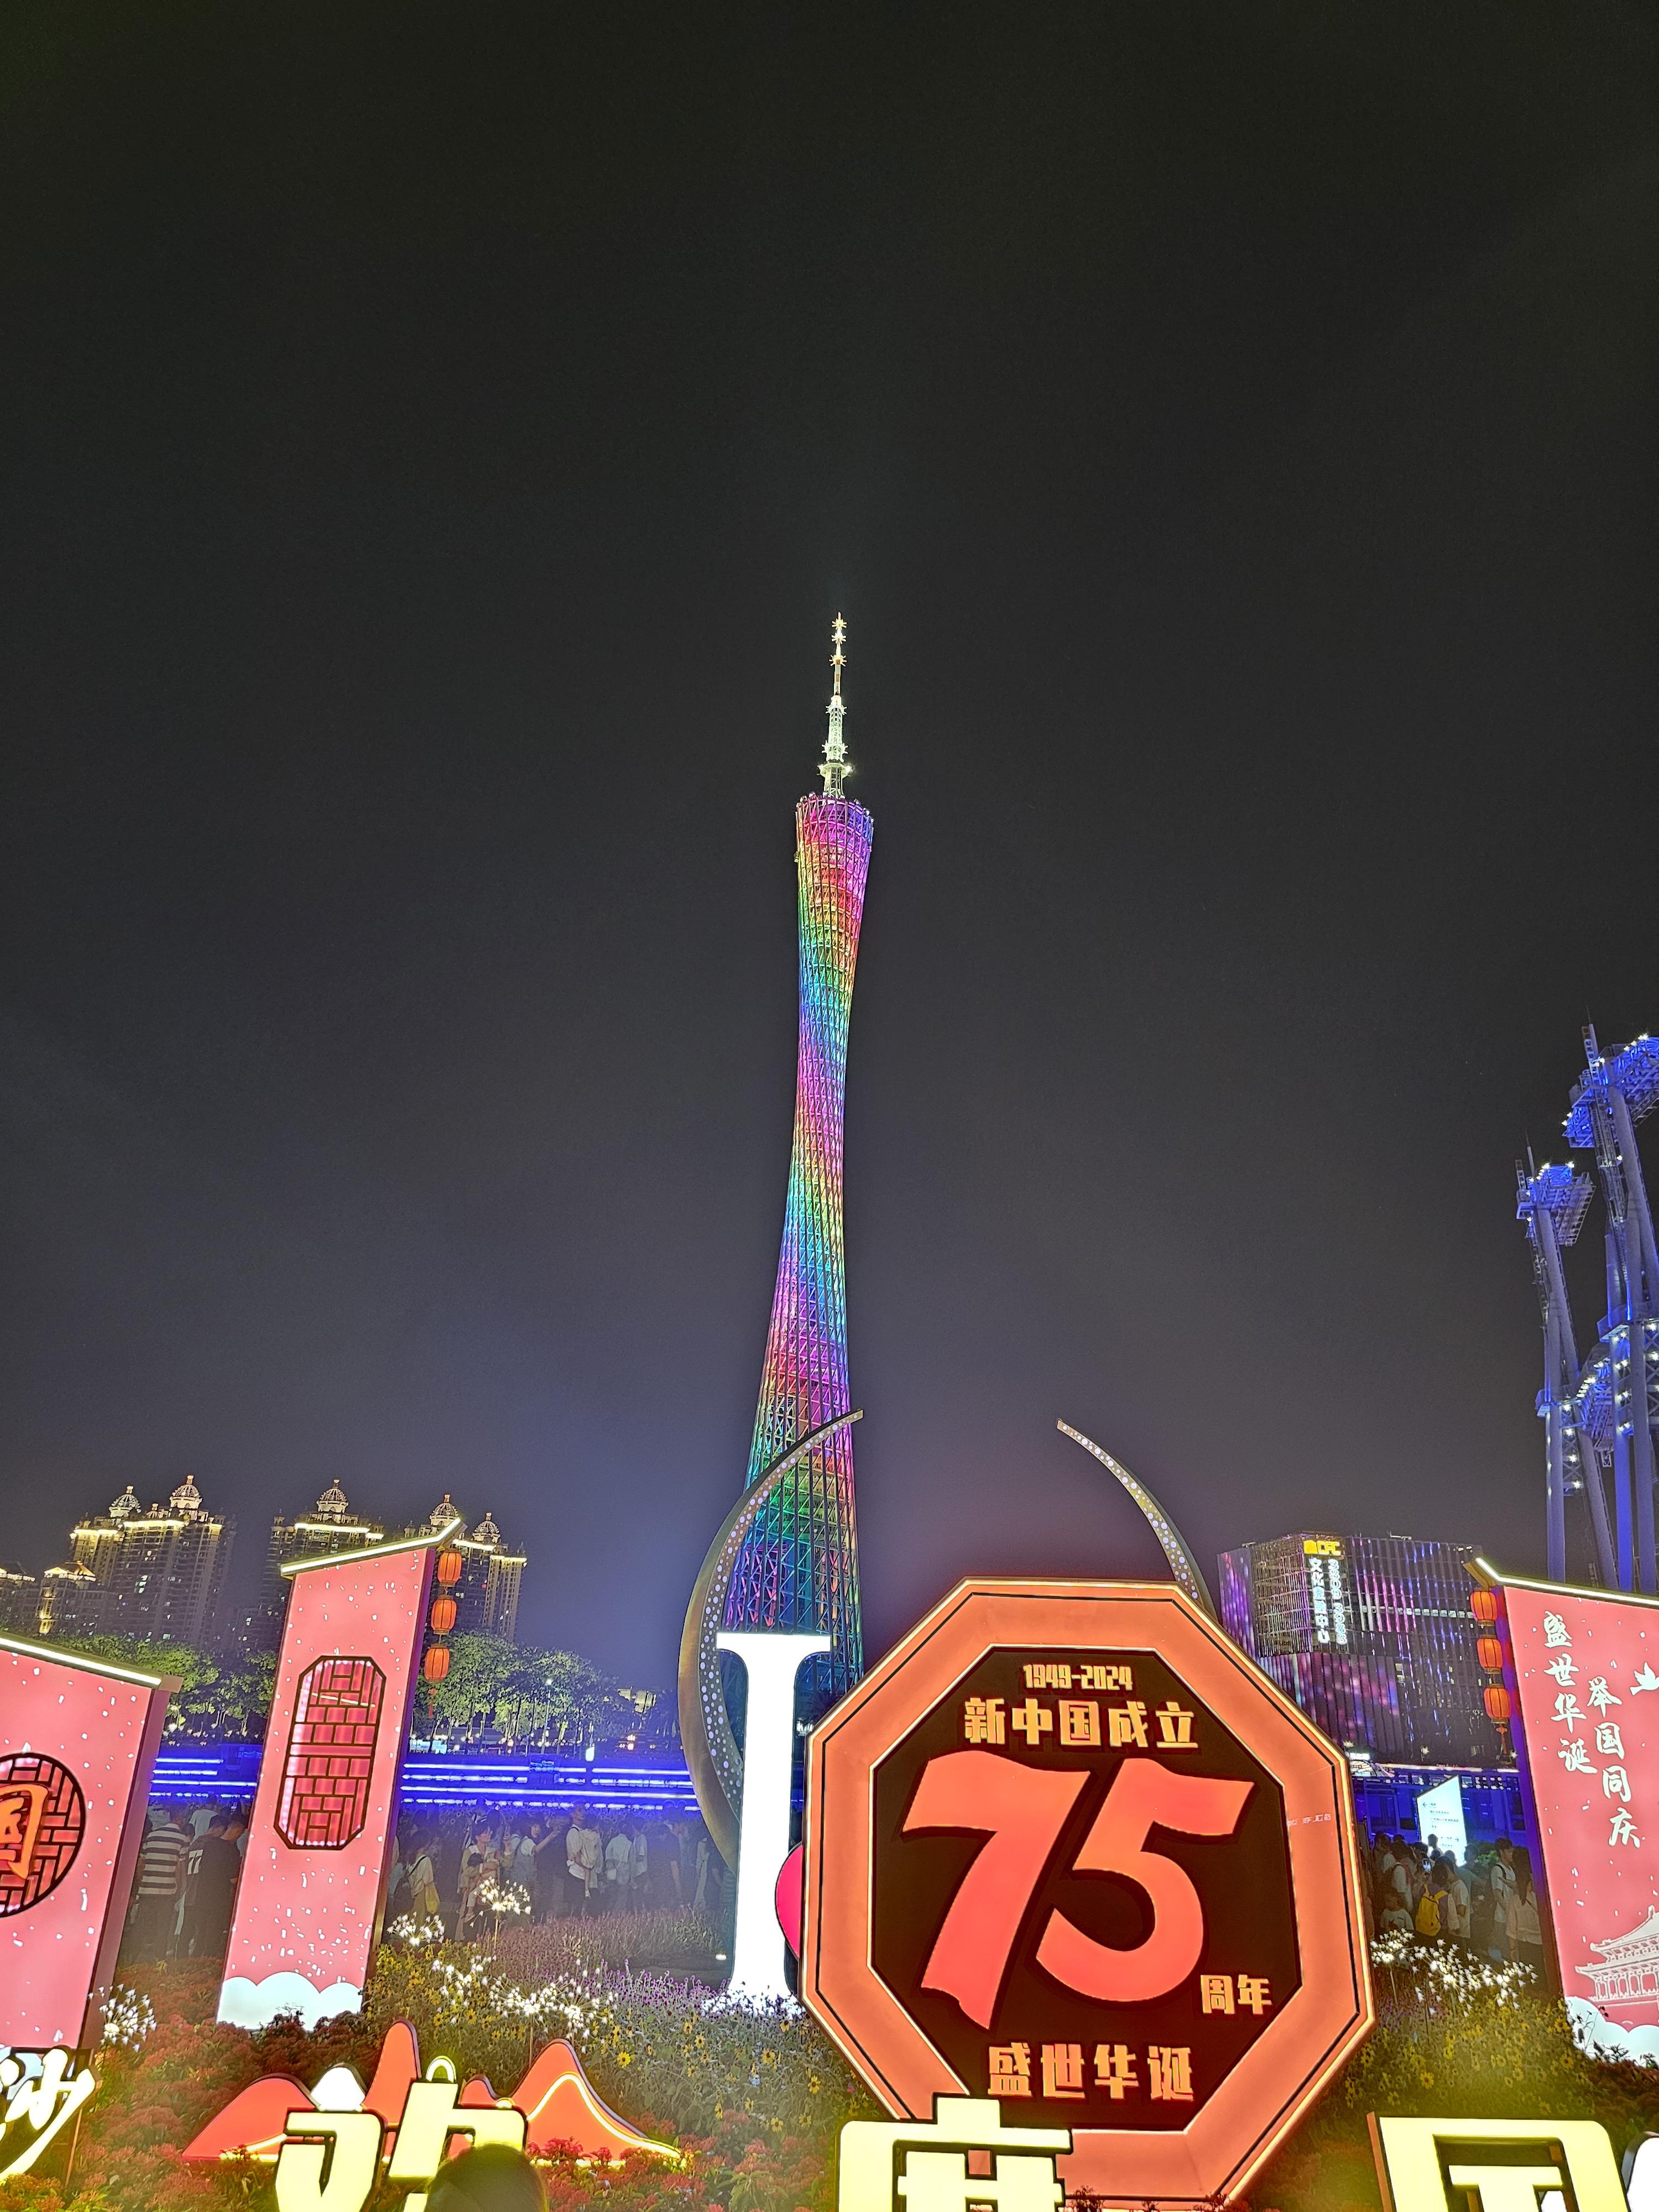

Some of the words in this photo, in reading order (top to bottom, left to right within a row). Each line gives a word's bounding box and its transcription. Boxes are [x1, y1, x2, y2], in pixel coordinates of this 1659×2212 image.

[1023, 1665, 1133, 1691] 1949-2024
[1543, 1610, 1598, 1773] 盛世华诞
[964, 1697, 1199, 1749] 新中国成立
[1587, 1676, 1641, 1848] 举国同庆
[187, 1849, 204, 1875] 77
[902, 1750, 1254, 2030] 75
[1200, 1974, 1272, 2015] 周年
[987, 2042, 1194, 2101] 盛世华诞
